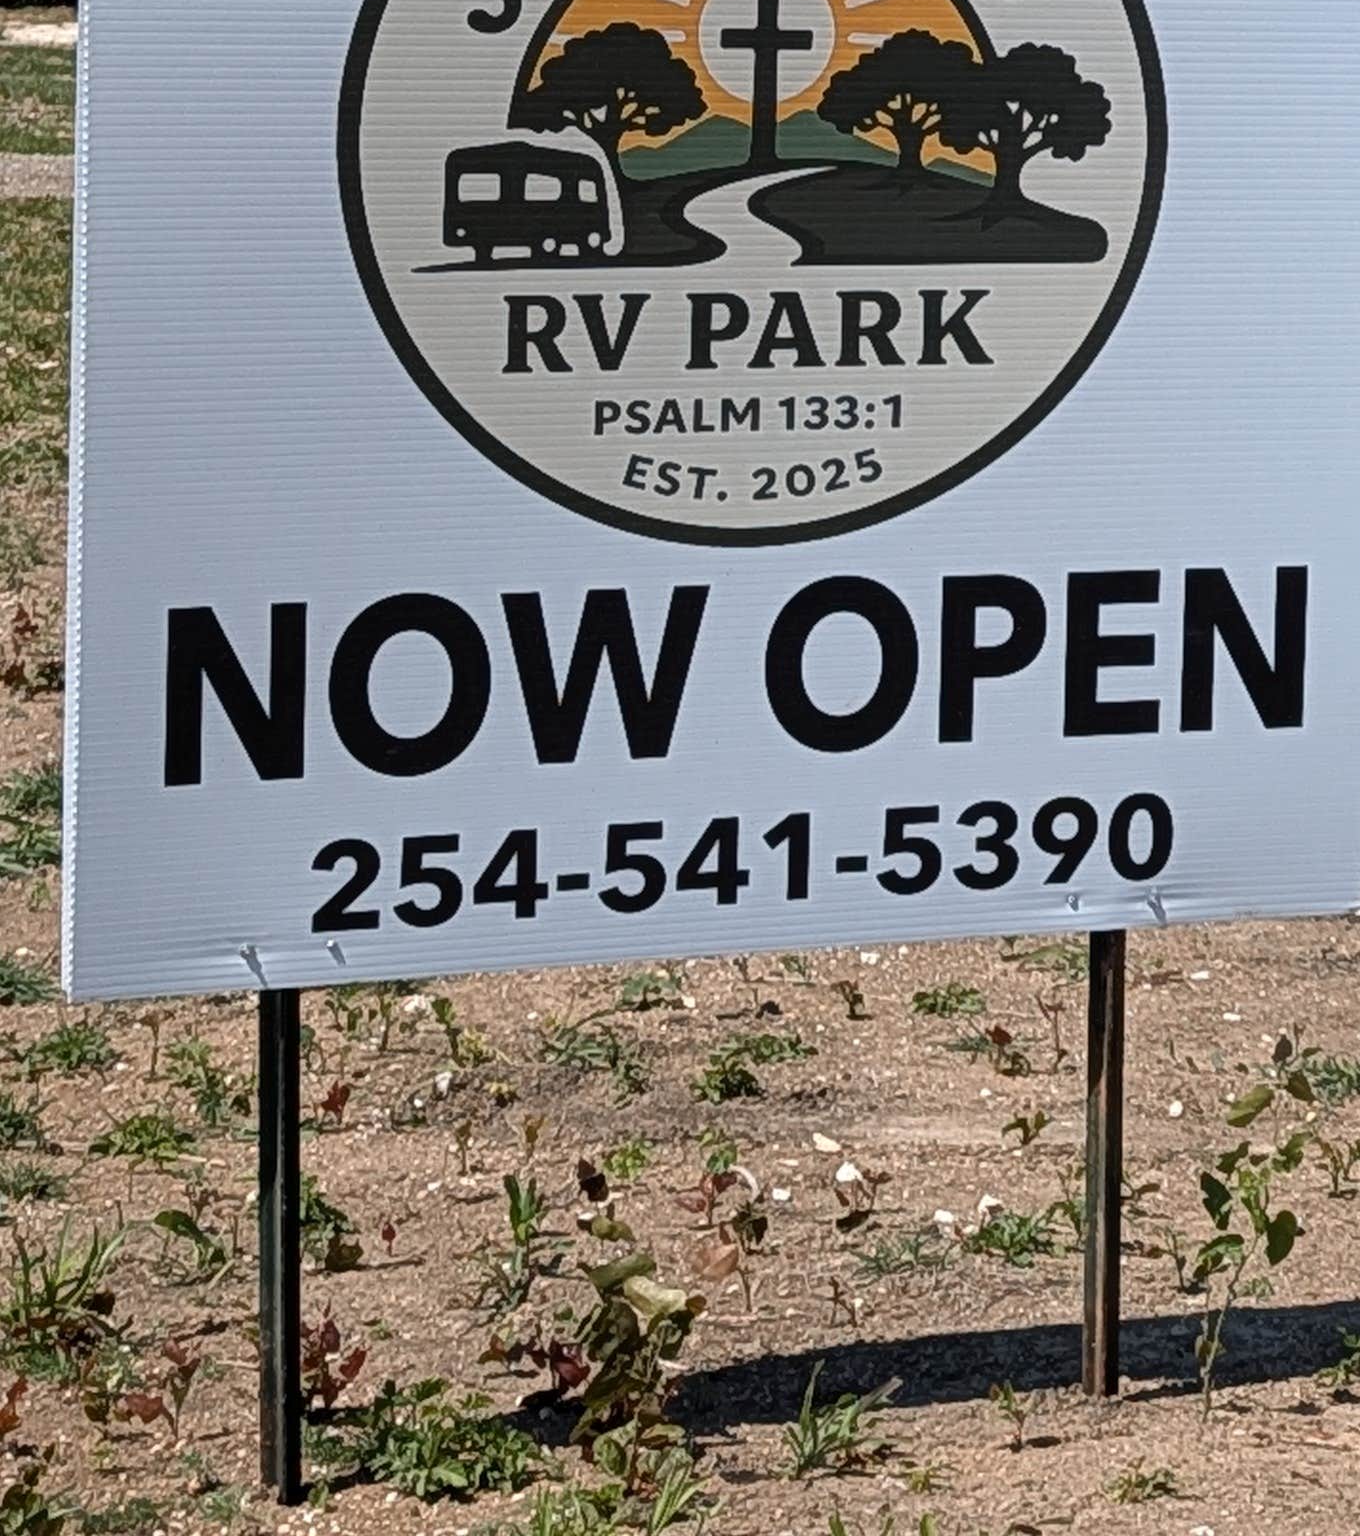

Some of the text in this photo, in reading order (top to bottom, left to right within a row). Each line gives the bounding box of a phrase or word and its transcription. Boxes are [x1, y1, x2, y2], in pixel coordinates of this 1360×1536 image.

[500, 288, 996, 375] RV PARK
[592, 393, 903, 437] PSALM 133:1
[621, 446, 886, 503] EST. 2025
[162, 564, 1309, 789] NOW OPEN
[310, 791, 1176, 936] 254-541-5390
